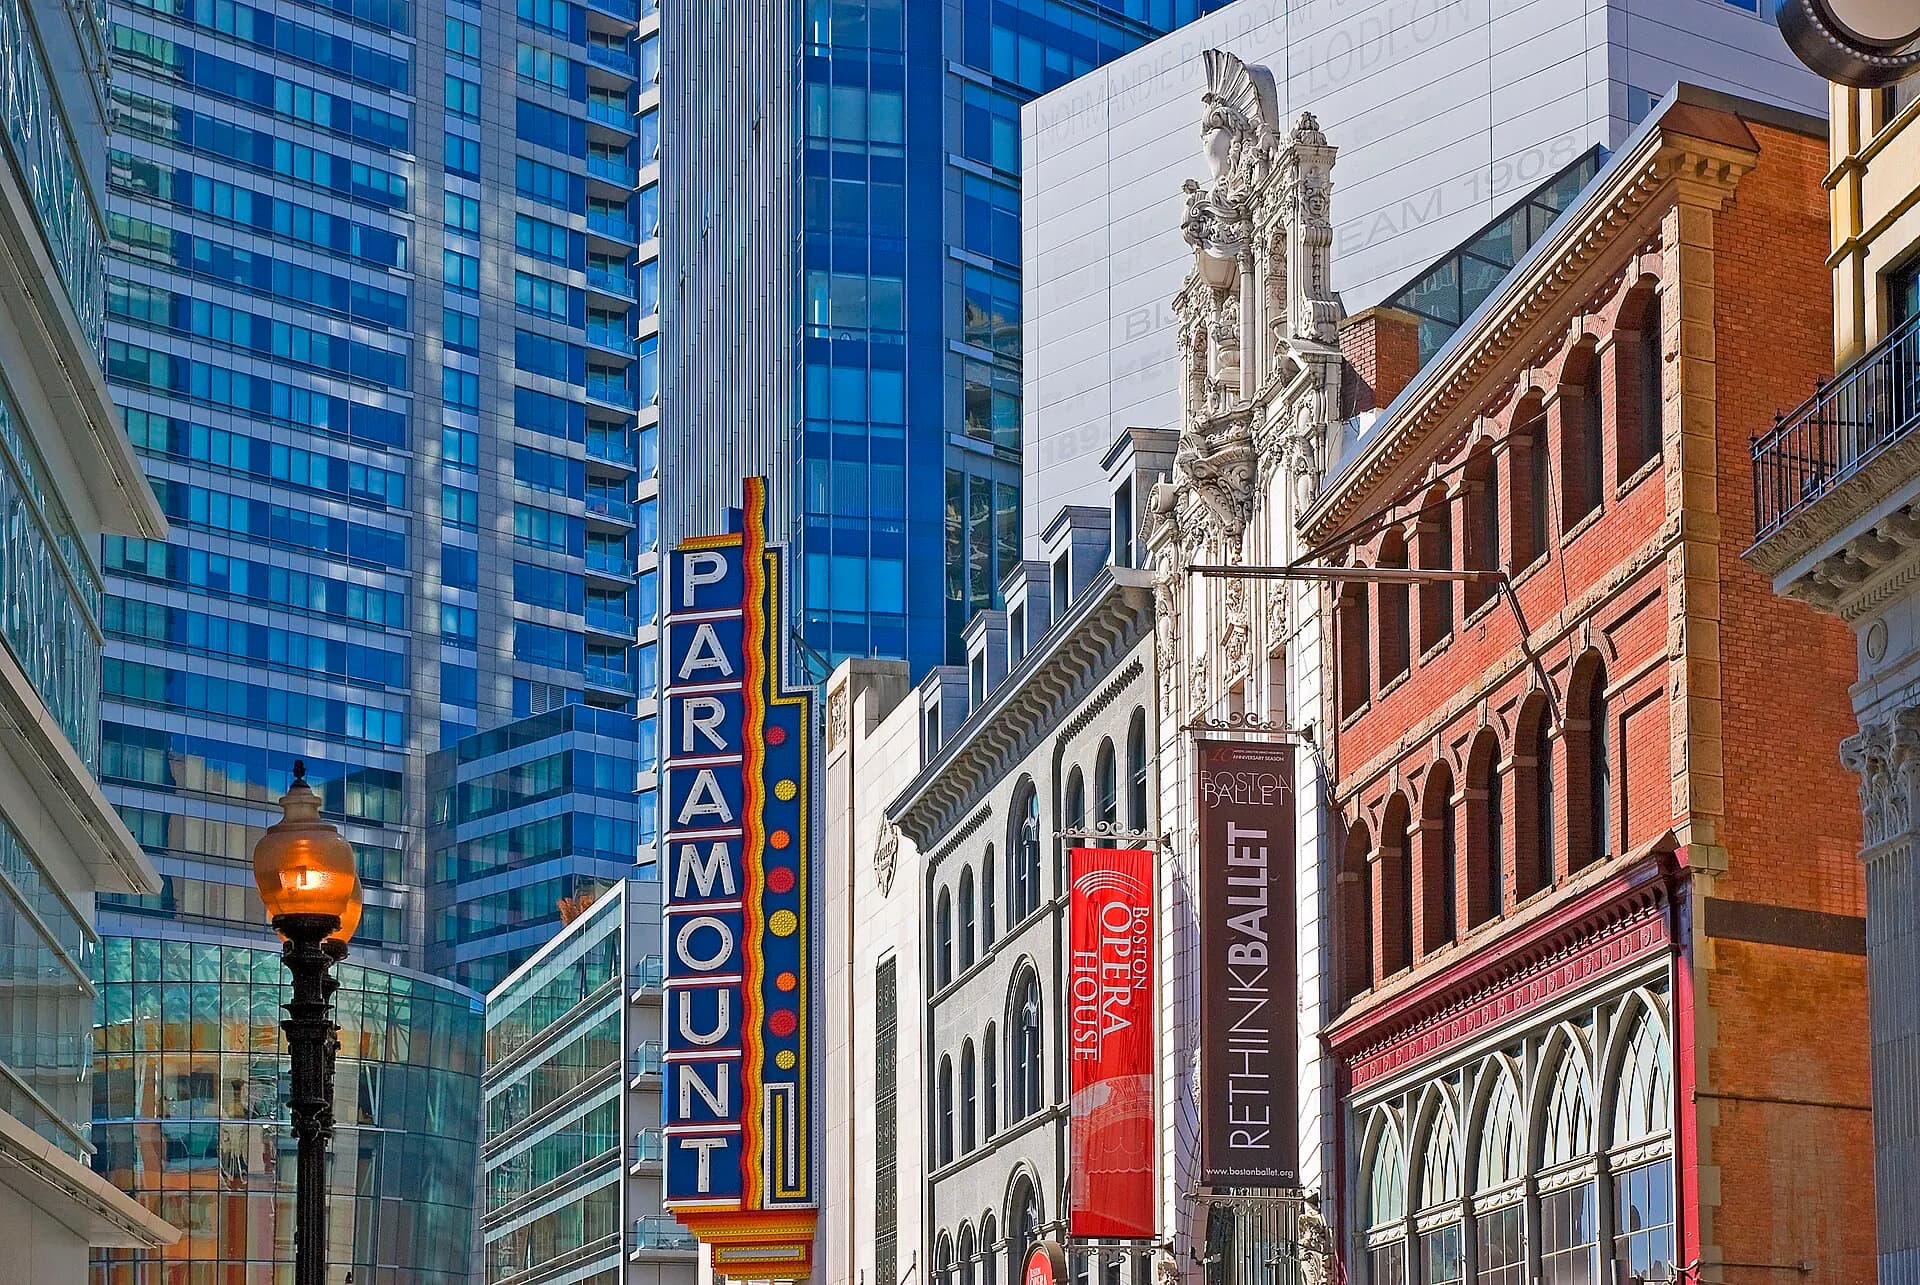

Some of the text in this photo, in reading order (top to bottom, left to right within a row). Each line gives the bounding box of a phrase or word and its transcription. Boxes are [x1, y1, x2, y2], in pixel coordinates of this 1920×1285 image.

[1040, 50, 1172, 149] NORMANDIE
[1463, 135, 1577, 201] 1908
[1200, 770, 1293, 793] BOSTON
[1204, 783, 1289, 809] BALLET
[675, 551, 736, 1193] PARAMOUNT
[1101, 901, 1132, 1038] OPERA
[1131, 906, 1150, 990] BOSTON
[1073, 949, 1098, 1062] HOUSE
[1205, 1166, 1295, 1179] www.bostonballet.org
